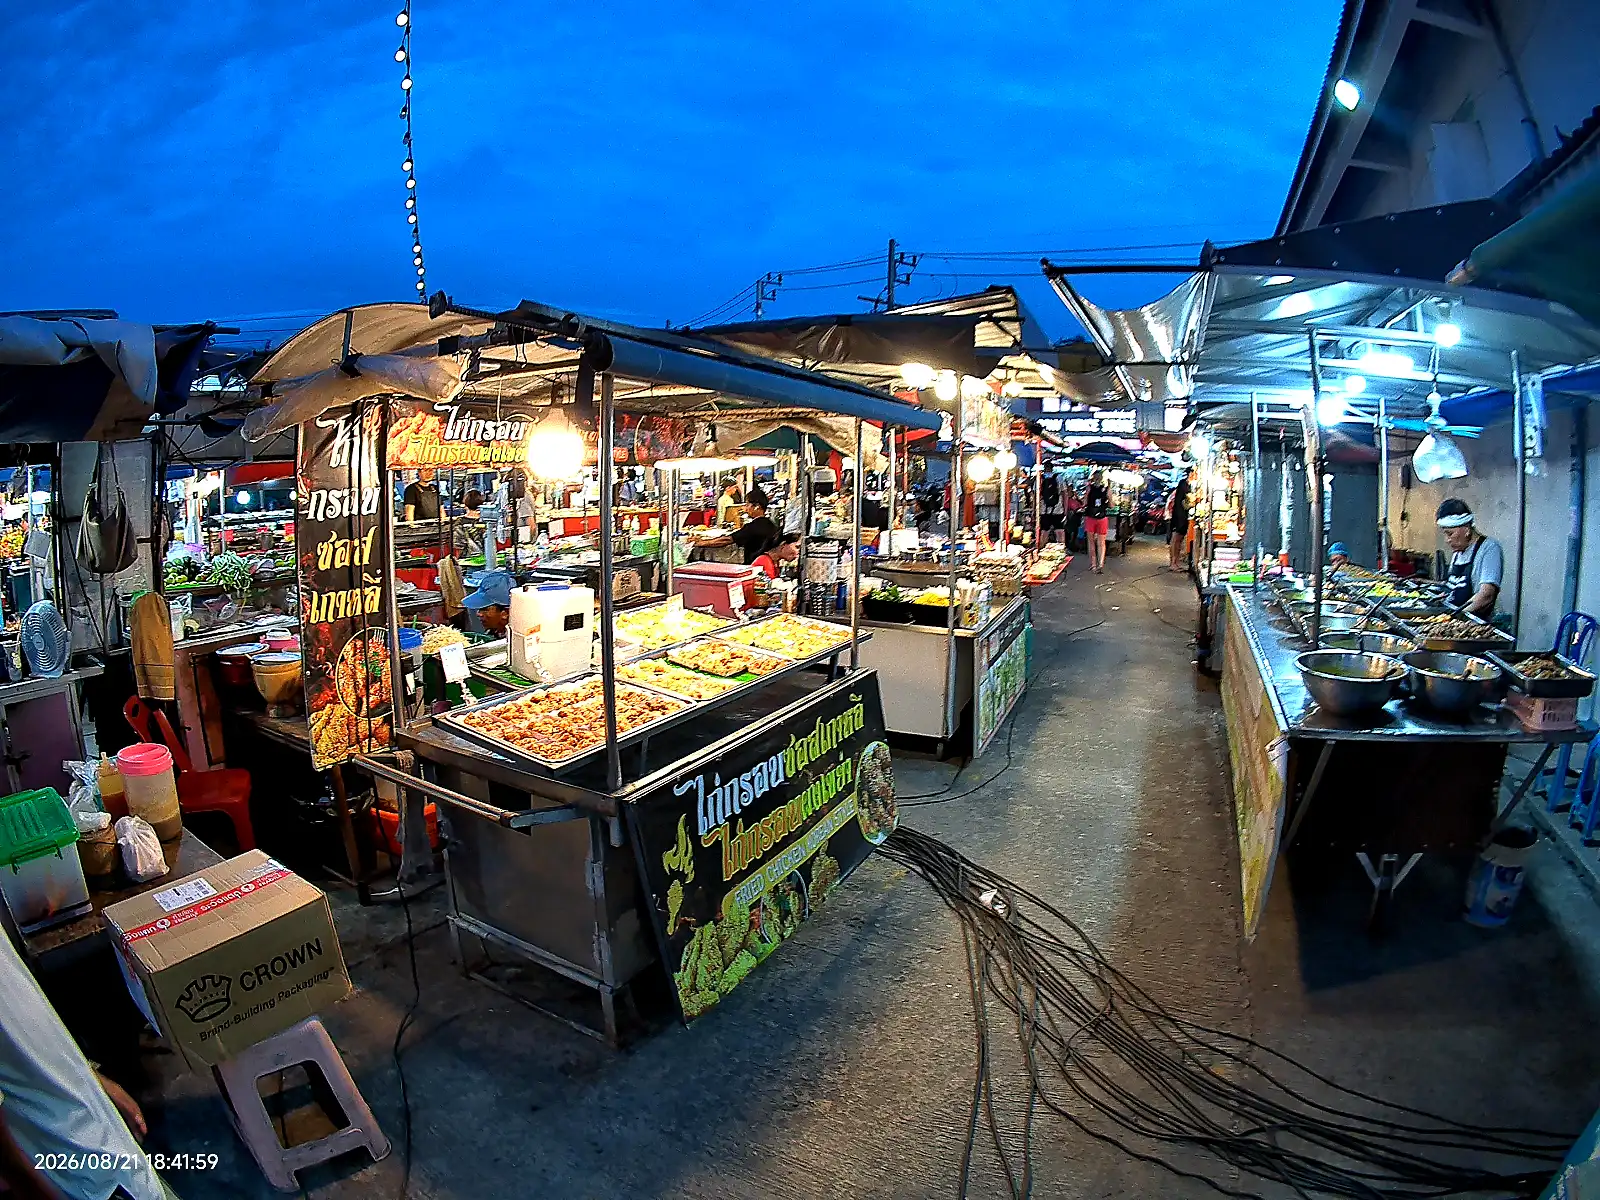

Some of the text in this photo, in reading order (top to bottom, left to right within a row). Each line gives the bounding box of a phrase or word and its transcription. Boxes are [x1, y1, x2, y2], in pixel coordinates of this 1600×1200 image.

[306, 487, 381, 522] กรอบ
[317, 526, 378, 571] ซอส
[734, 873, 766, 906] FRIED
[766, 845, 807, 882] CHICKEN
[239, 937, 323, 992] CROWN
[199, 997, 277, 1042] Brand-Building
